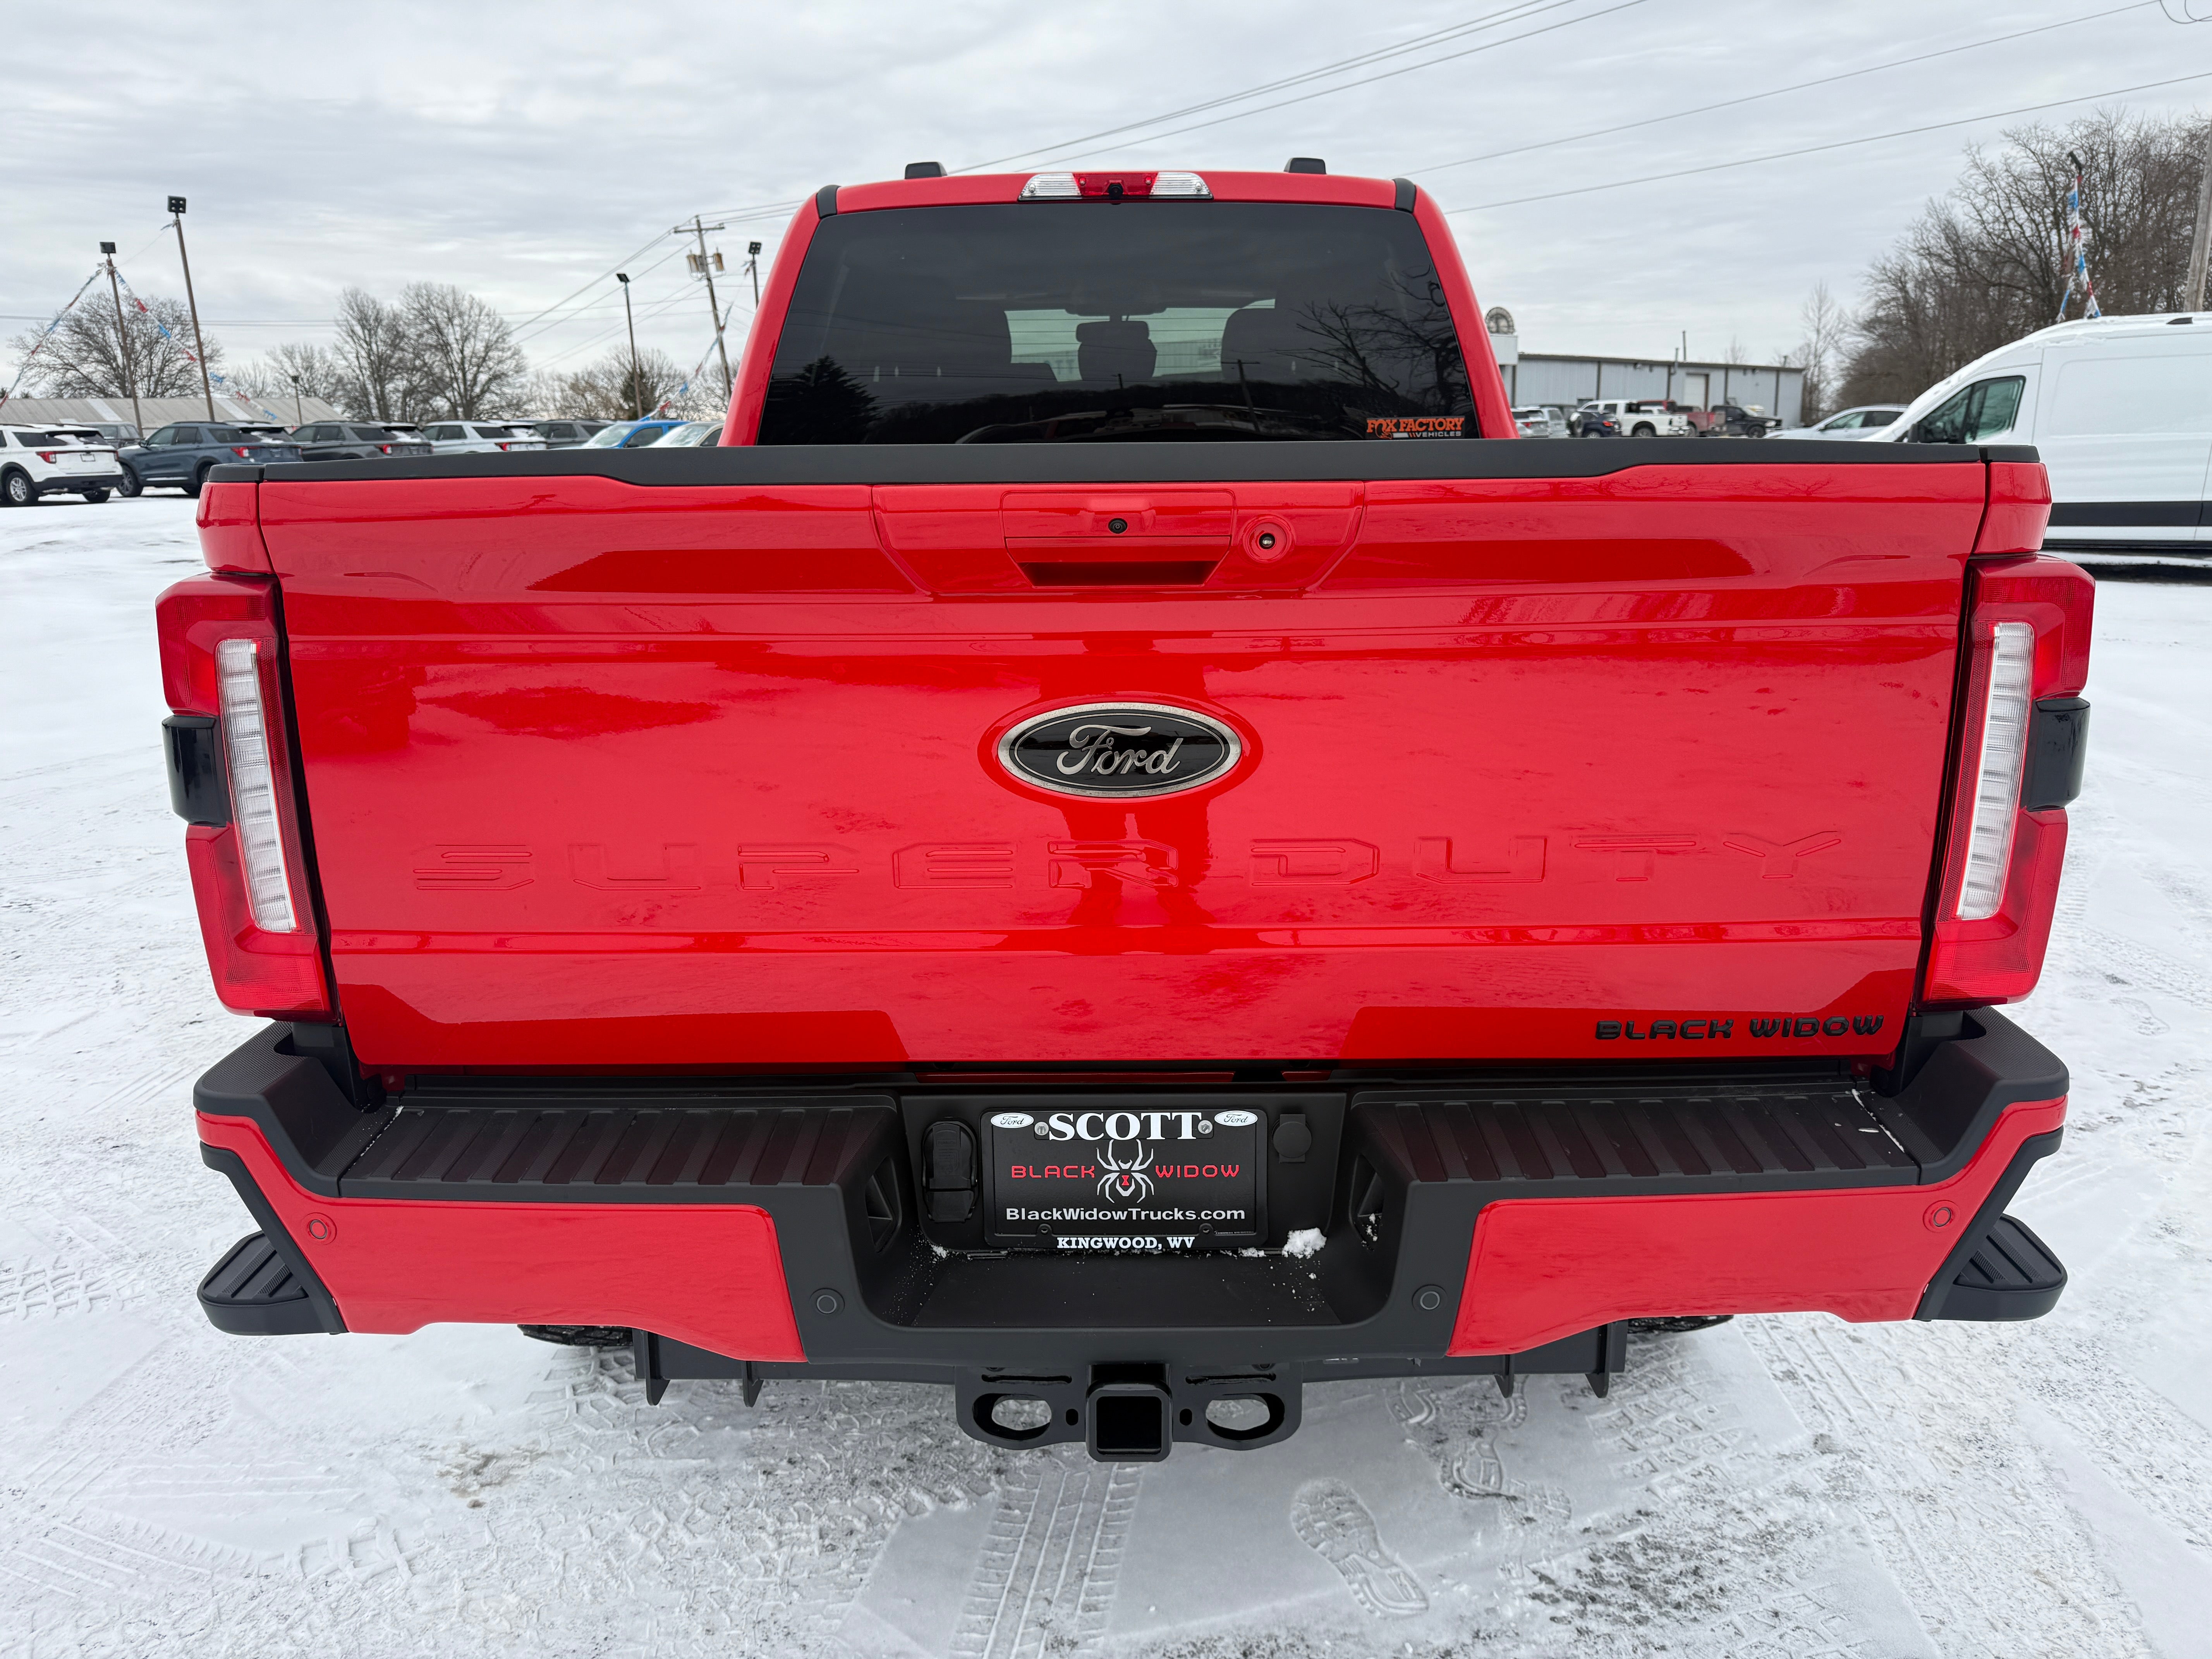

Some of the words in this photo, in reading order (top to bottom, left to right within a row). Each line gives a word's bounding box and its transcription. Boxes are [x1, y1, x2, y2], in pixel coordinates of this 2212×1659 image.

[1367, 419, 1397, 439] FOX
[1399, 418, 1464, 431] FACTORY
[1056, 725, 1183, 775] Ford
[413, 840, 1178, 891] SUPER
[1249, 830, 1842, 887] DUTY
[1595, 1019, 1734, 1040] BLACK
[1749, 1015, 1884, 1038] WIDOW
[1000, 1116, 1024, 1125] Ford
[1049, 1112, 1202, 1141] SCOTT
[1224, 1113, 1248, 1123] Ford
[1011, 1165, 1095, 1178] BLACK
[1155, 1164, 1240, 1178] WIDOW
[1006, 1207, 1245, 1221] BlackWidowTrucks.com
[1057, 1237, 1162, 1250] KINGWOOD,
[1166, 1237, 1195, 1249] WV
